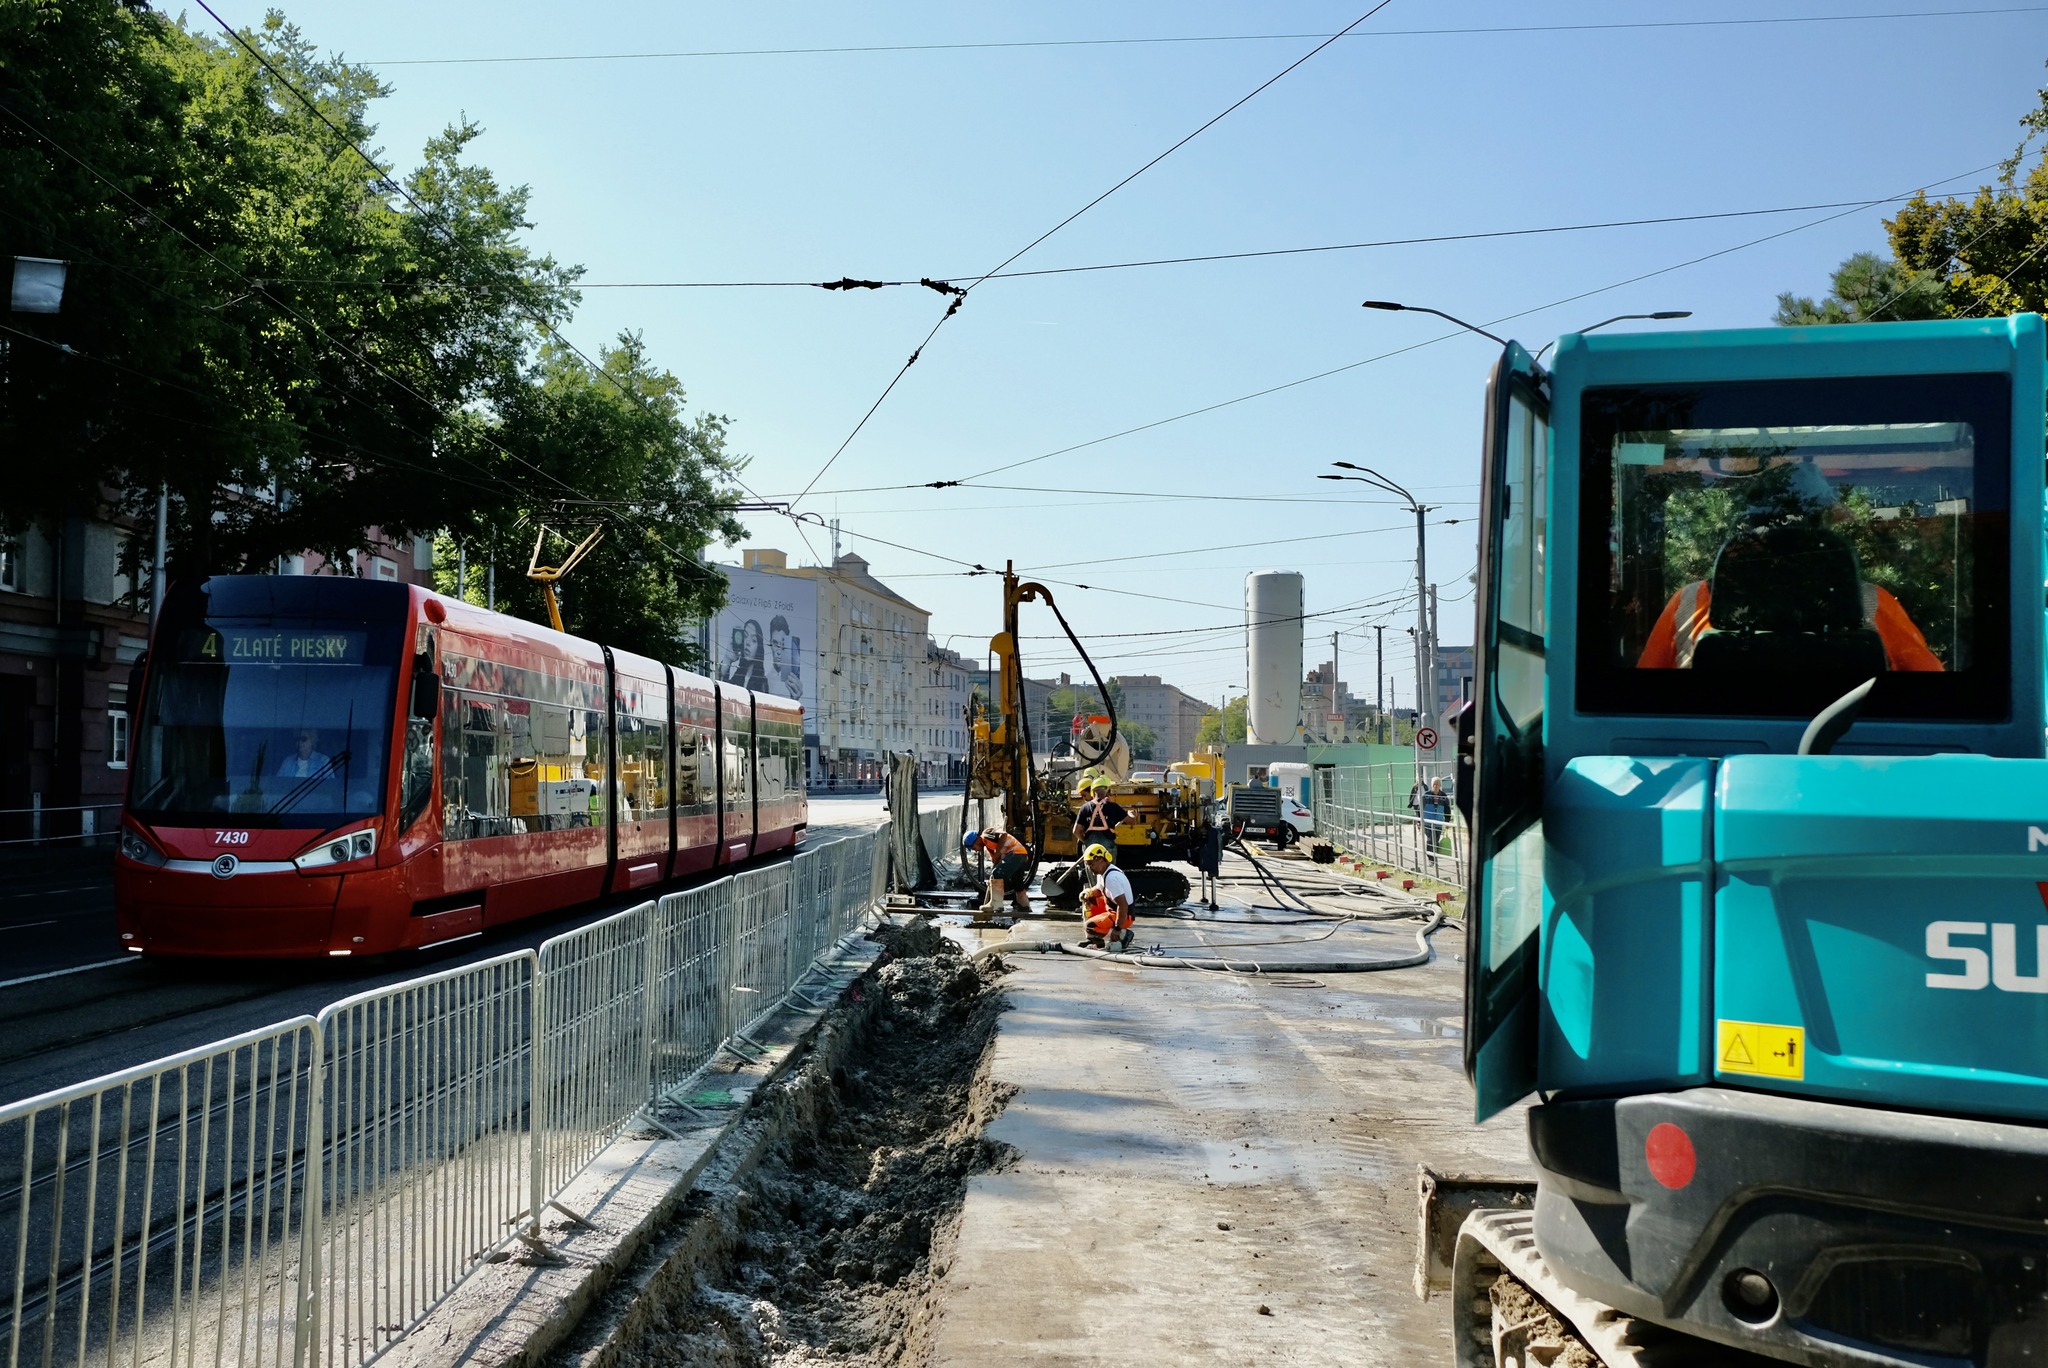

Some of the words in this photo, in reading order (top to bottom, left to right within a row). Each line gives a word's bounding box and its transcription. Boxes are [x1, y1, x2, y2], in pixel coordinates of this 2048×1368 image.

[731, 593, 752, 607] Galaxy
[201, 633, 217, 657] 4
[233, 634, 282, 657] ZLATÉ
[291, 638, 347, 658] PIESKY
[214, 831, 249, 845] 7430
